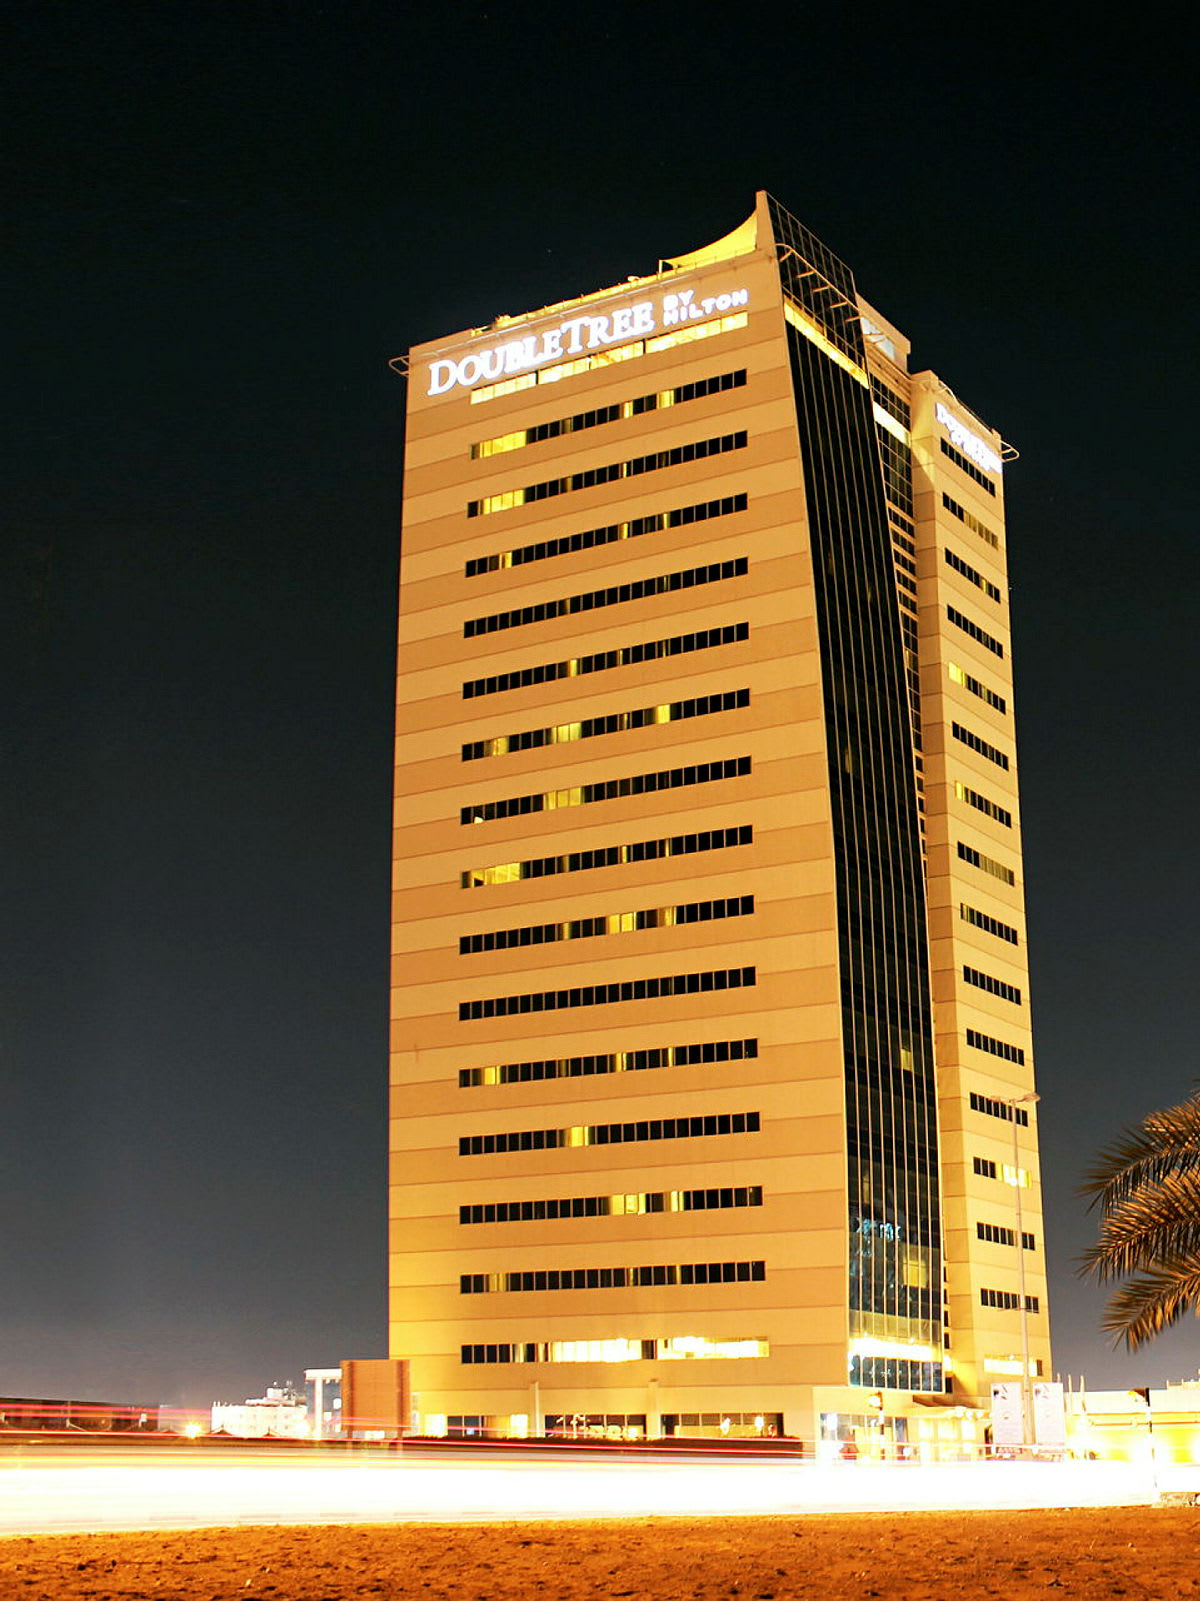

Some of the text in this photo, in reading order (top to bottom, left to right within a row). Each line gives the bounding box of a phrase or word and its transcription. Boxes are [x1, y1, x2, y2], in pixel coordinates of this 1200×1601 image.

[663, 290, 694, 311] BY
[663, 289, 748, 327] HILTON
[427, 302, 655, 395] DOUBLETREE
